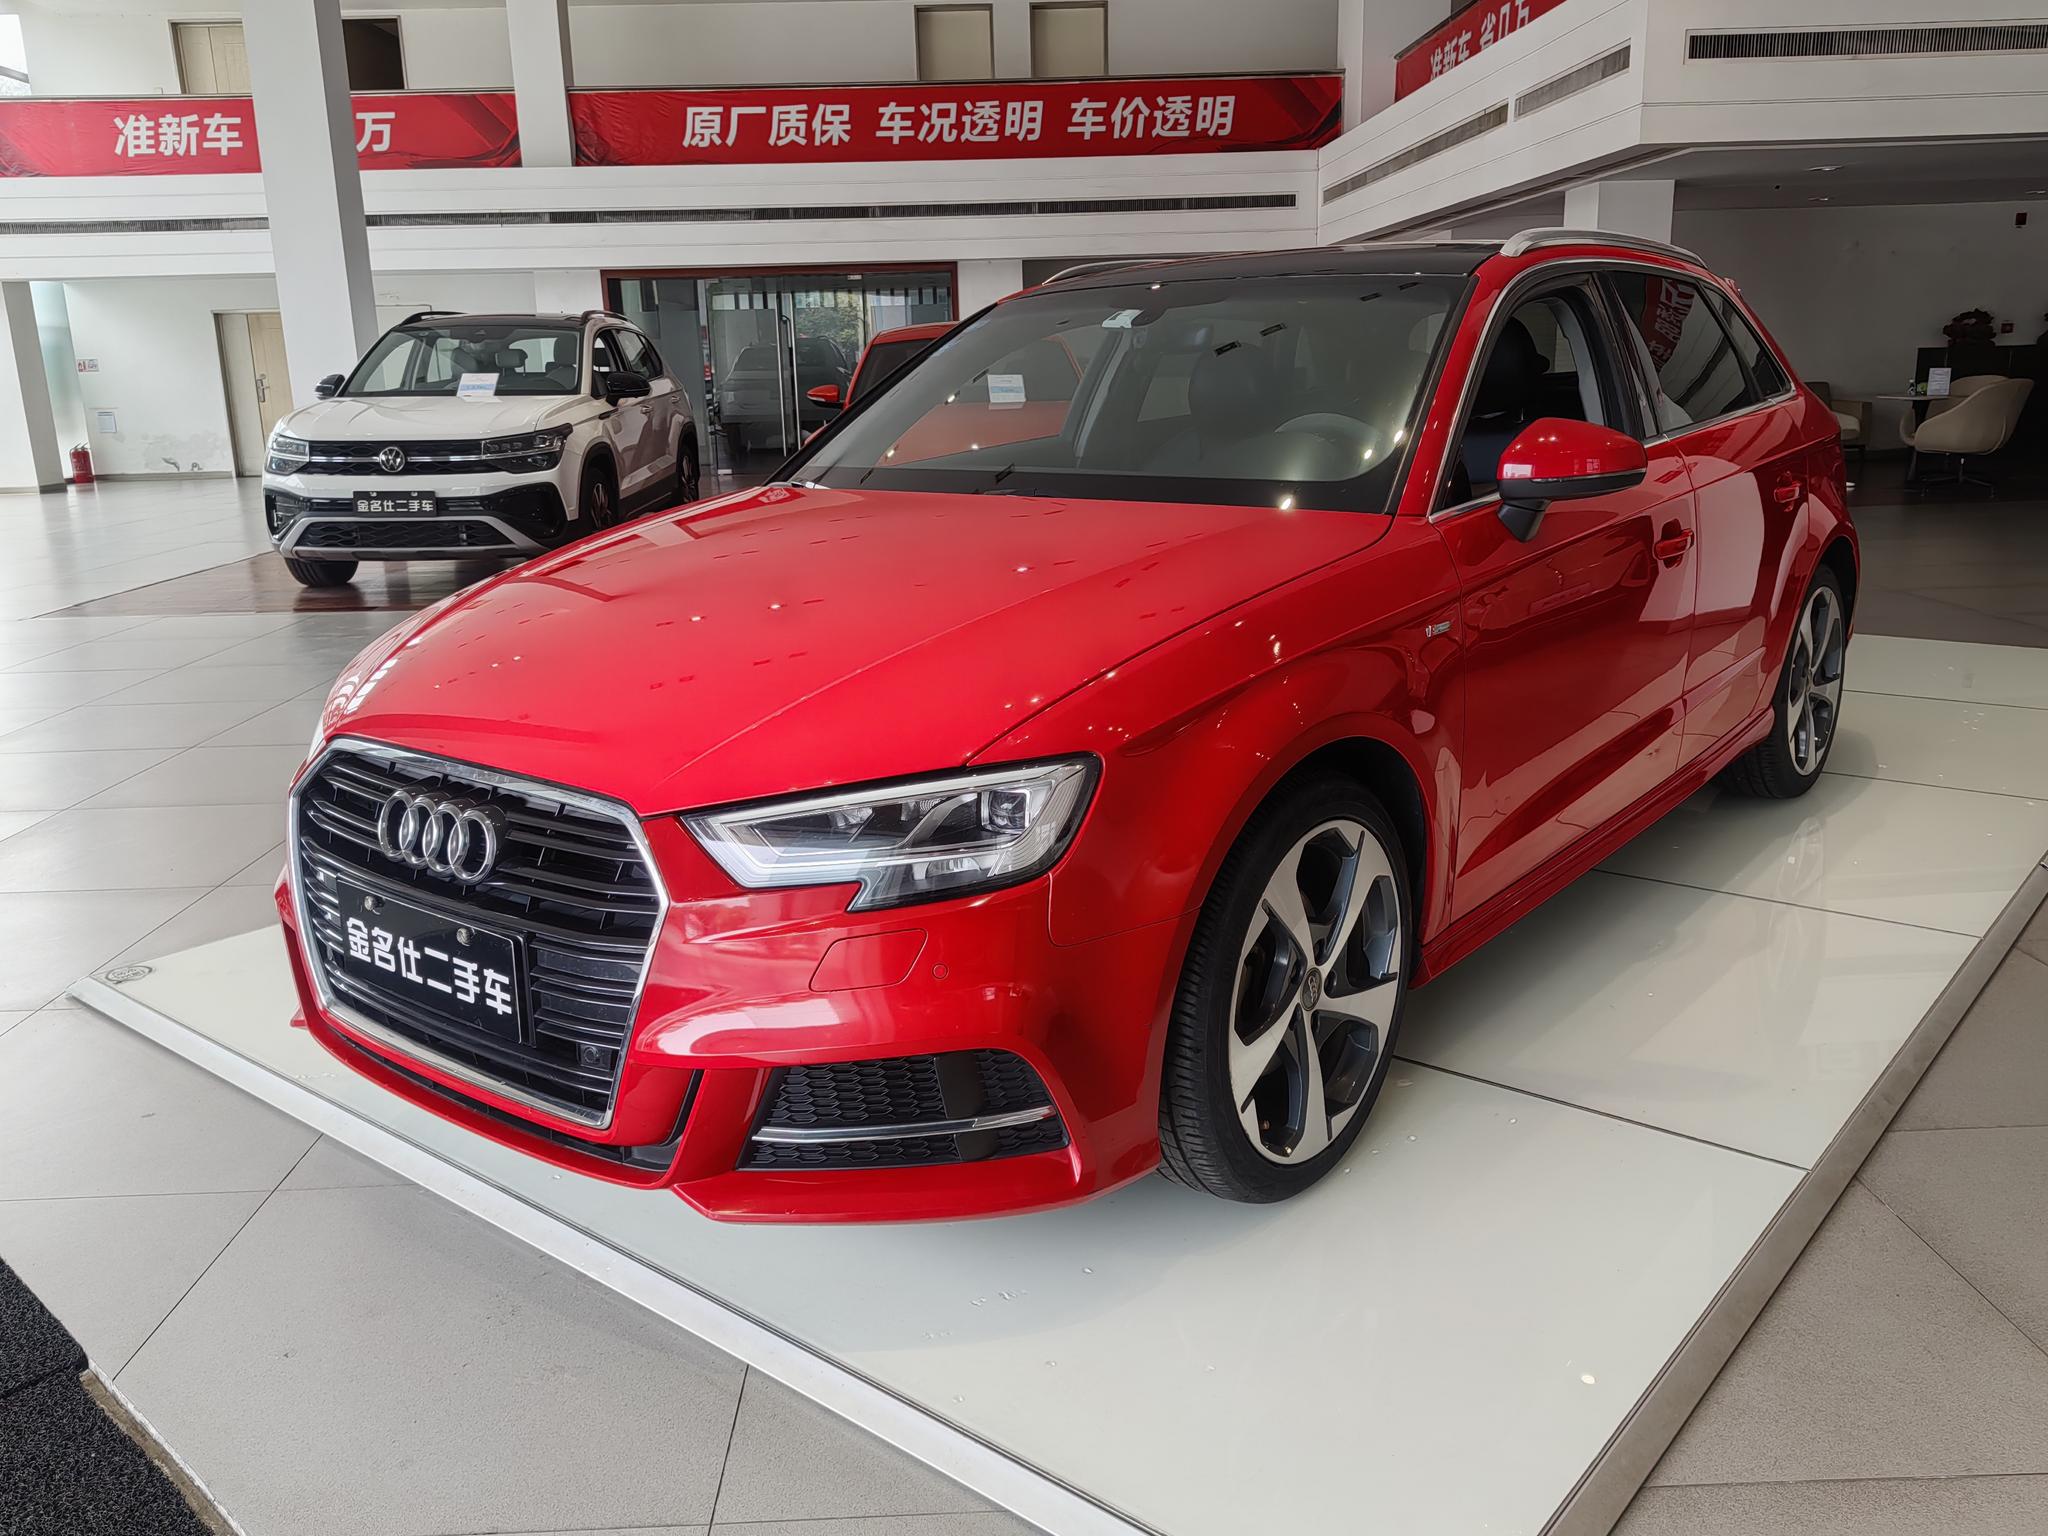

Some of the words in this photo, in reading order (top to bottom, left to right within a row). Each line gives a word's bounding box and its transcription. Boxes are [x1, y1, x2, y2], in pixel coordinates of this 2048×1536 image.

[113, 113, 243, 158] 准新车
[682, 103, 852, 148] 原厂质保
[875, 100, 1044, 145] 车况透明
[1067, 95, 1236, 141] 车价透明
[357, 500, 434, 512] 金名仕二手车
[346, 917, 512, 1015] 金名仕二手车
